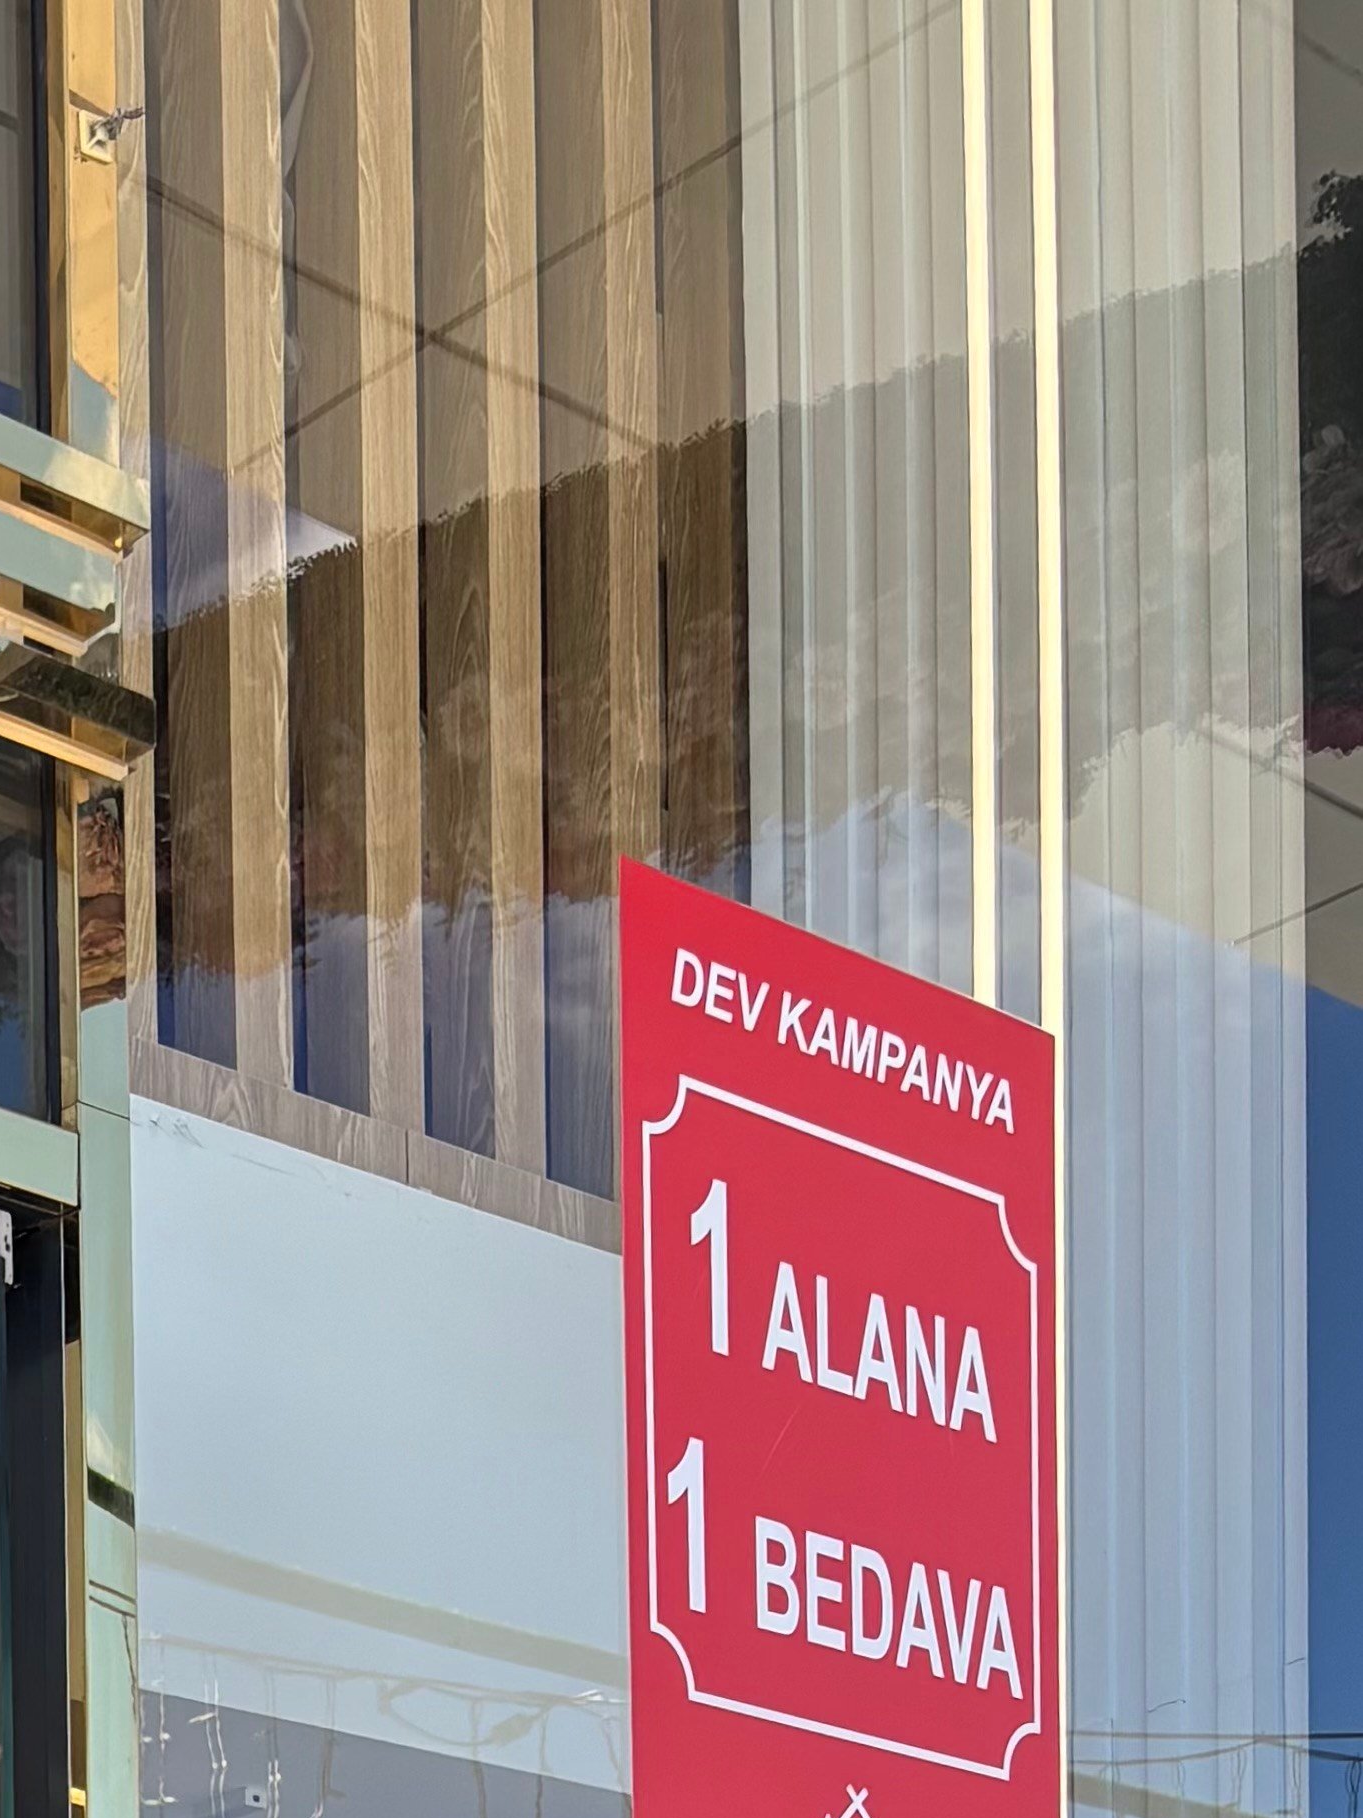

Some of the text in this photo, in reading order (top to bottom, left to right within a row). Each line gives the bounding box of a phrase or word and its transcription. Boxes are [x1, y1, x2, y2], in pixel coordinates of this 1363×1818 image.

[671, 948, 1015, 1134] DEV KAMPANYA
[689, 1178, 999, 1445] 1 ALANA
[667, 1437, 1025, 1700] 1 BEDAVA
